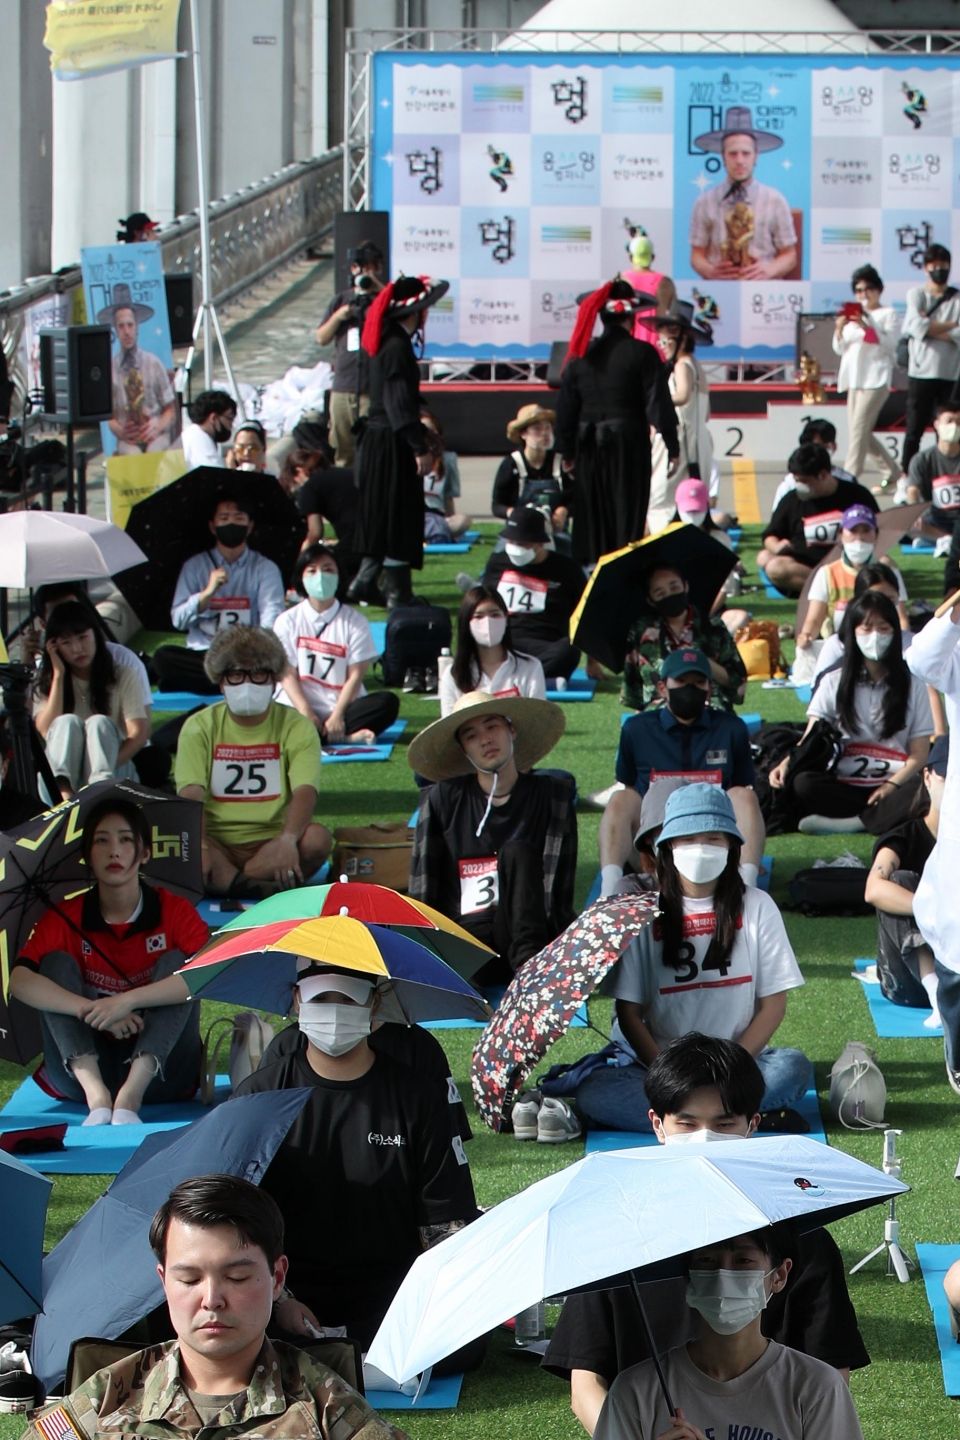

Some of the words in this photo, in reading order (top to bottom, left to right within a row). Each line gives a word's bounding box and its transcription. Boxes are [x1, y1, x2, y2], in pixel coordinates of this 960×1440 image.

[724, 427, 744, 457] 2
[884, 435, 899, 460] 3
[814, 522, 841, 541] 07
[506, 586, 534, 611] 14
[306, 652, 337, 680] 17
[224, 763, 267, 795] 25
[852, 758, 891, 779] 23
